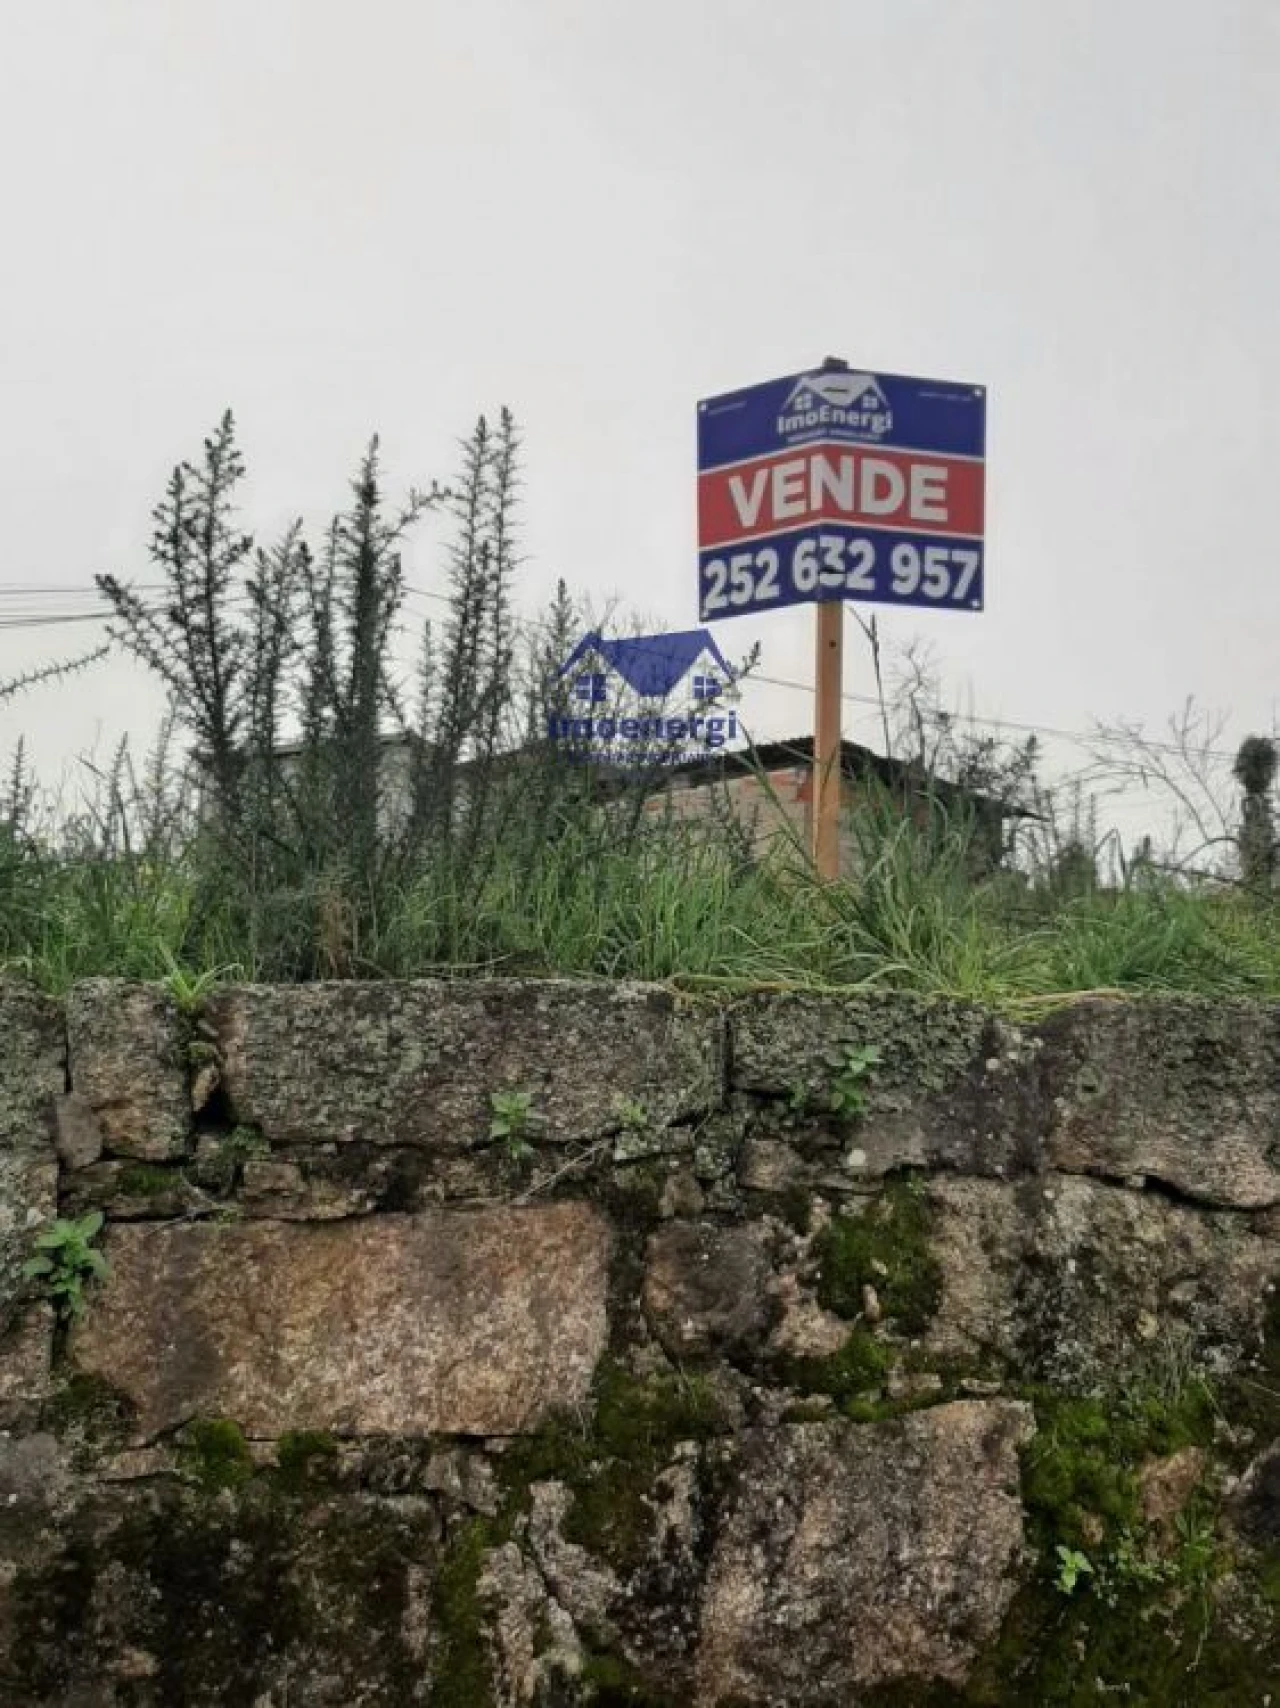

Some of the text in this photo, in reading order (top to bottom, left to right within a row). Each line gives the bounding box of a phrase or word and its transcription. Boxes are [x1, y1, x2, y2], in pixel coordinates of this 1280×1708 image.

[777, 404, 893, 434] ImoEnergi
[728, 455, 949, 528] VENDE
[704, 535, 979, 610] 252 632 957
